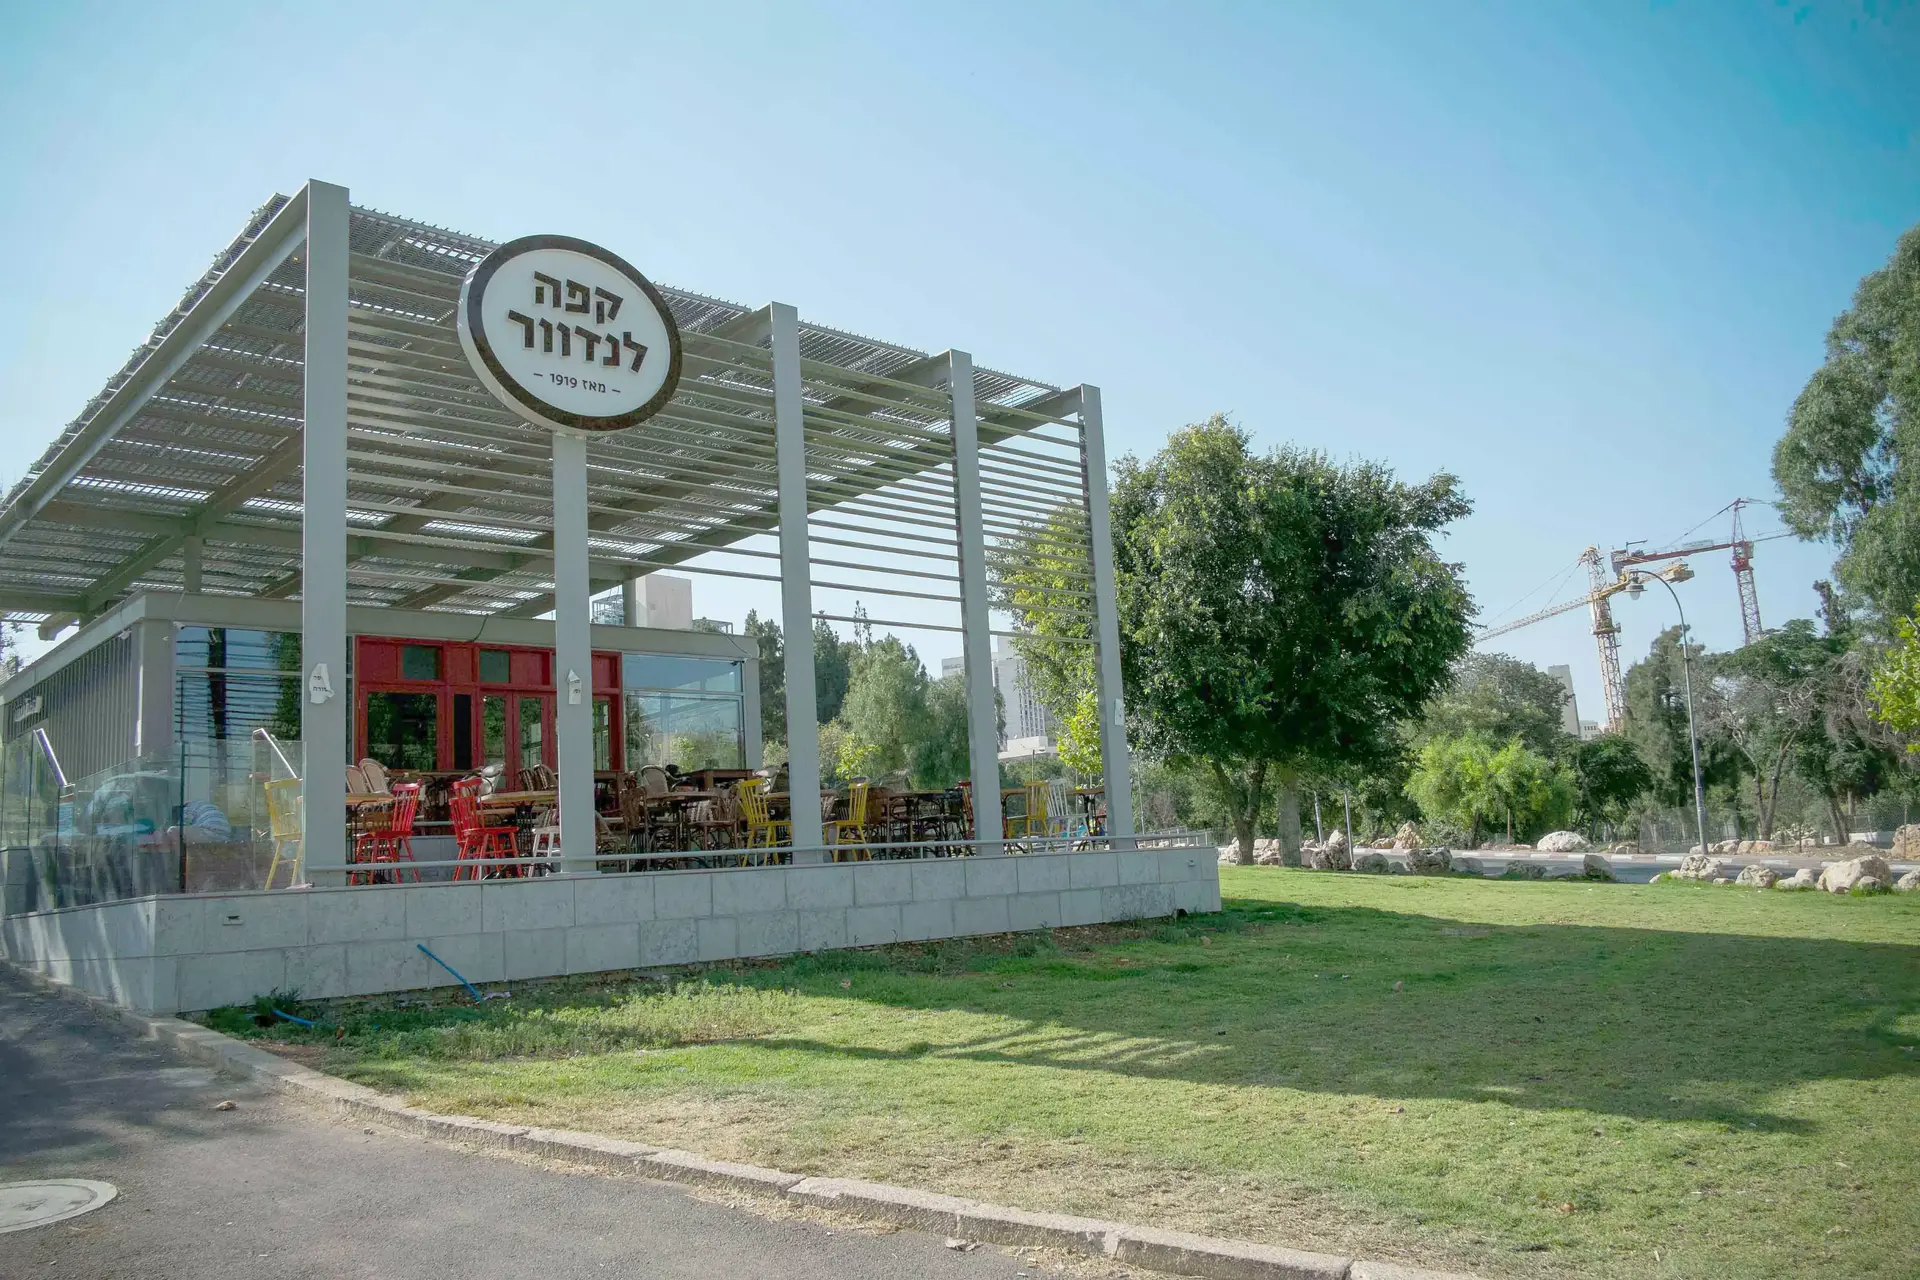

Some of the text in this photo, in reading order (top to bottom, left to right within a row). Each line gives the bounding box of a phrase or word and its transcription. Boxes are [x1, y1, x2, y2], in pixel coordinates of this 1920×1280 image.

[534, 270, 624, 324] קפה
[508, 309, 648, 373] לנדוור
[550, 373, 606, 393] מאז 1919
